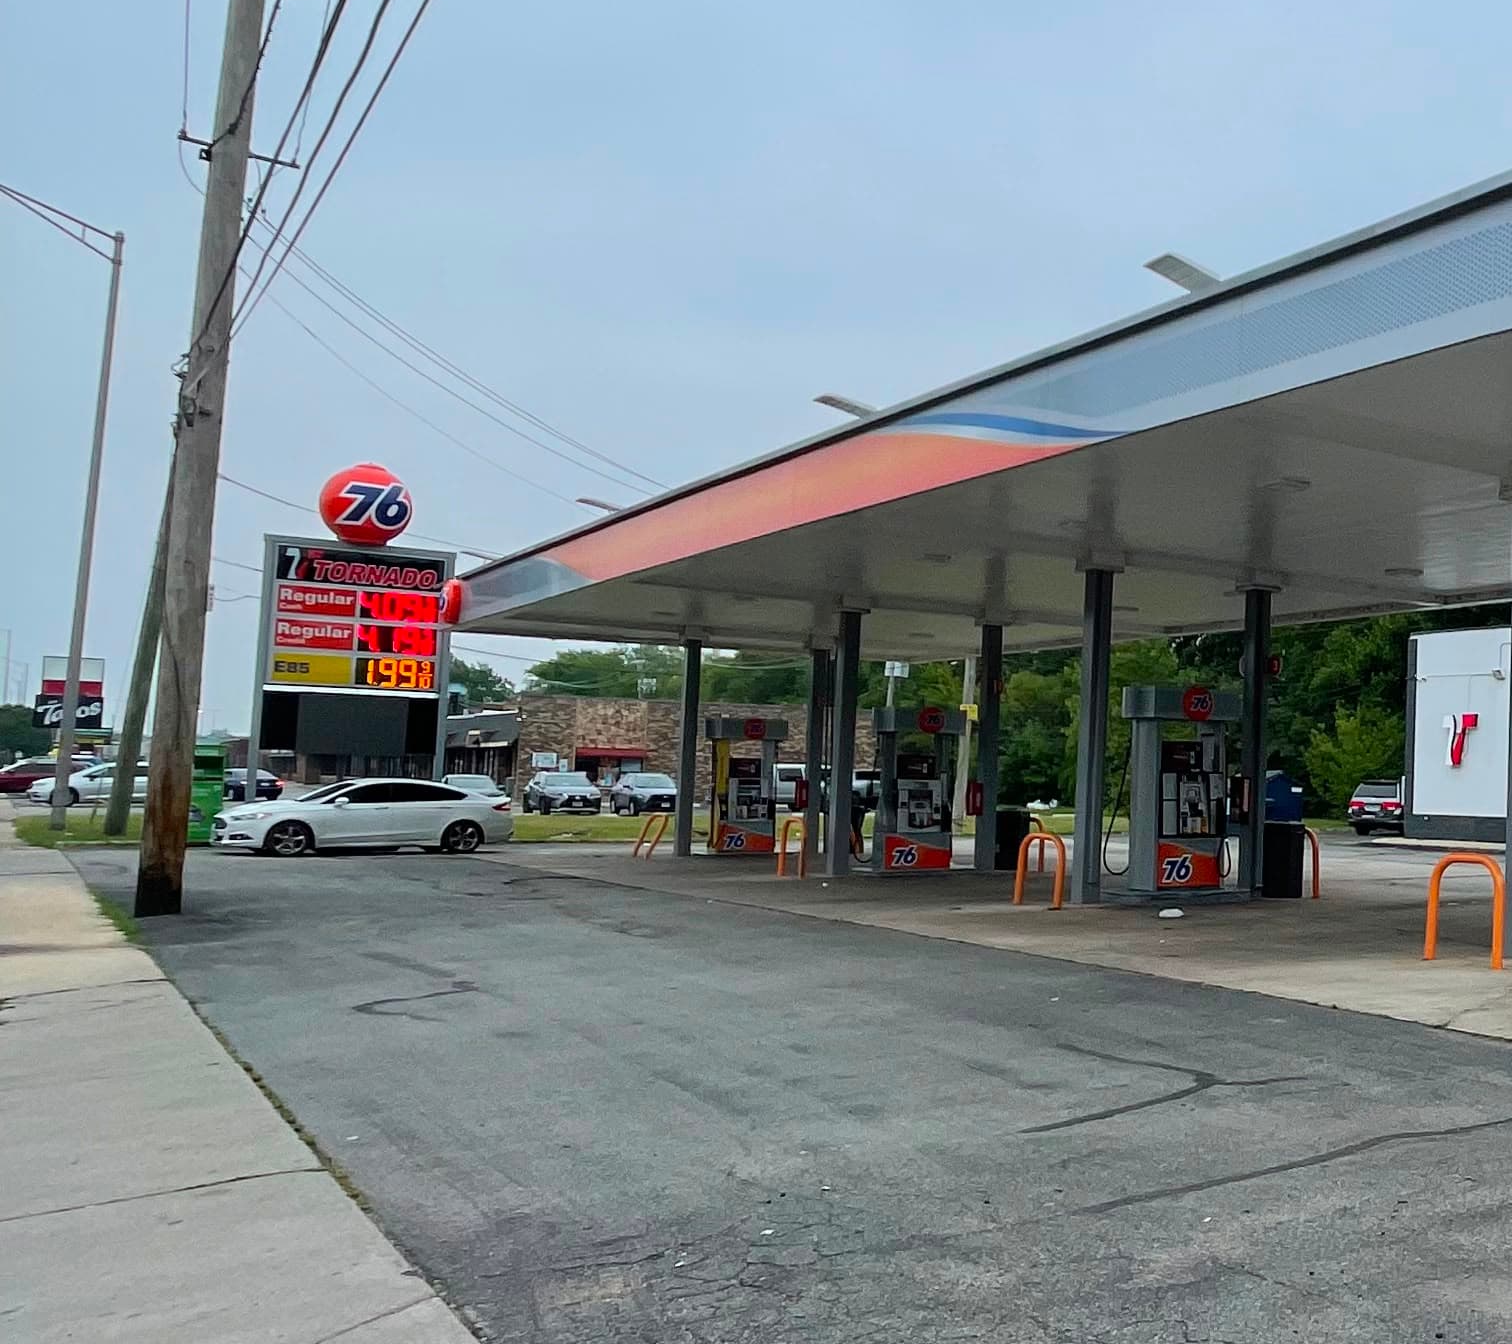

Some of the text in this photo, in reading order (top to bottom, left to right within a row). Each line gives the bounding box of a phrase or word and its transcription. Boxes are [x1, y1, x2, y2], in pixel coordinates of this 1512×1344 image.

[336, 481, 411, 530] 76
[314, 560, 438, 590] TORNADO
[279, 588, 355, 605] Regular
[277, 622, 353, 639] Regular
[274, 660, 310, 674] E85
[36, 701, 102, 725] Taos
[723, 833, 746, 849] 76
[891, 844, 918, 867] 76
[1160, 854, 1193, 884] 76
